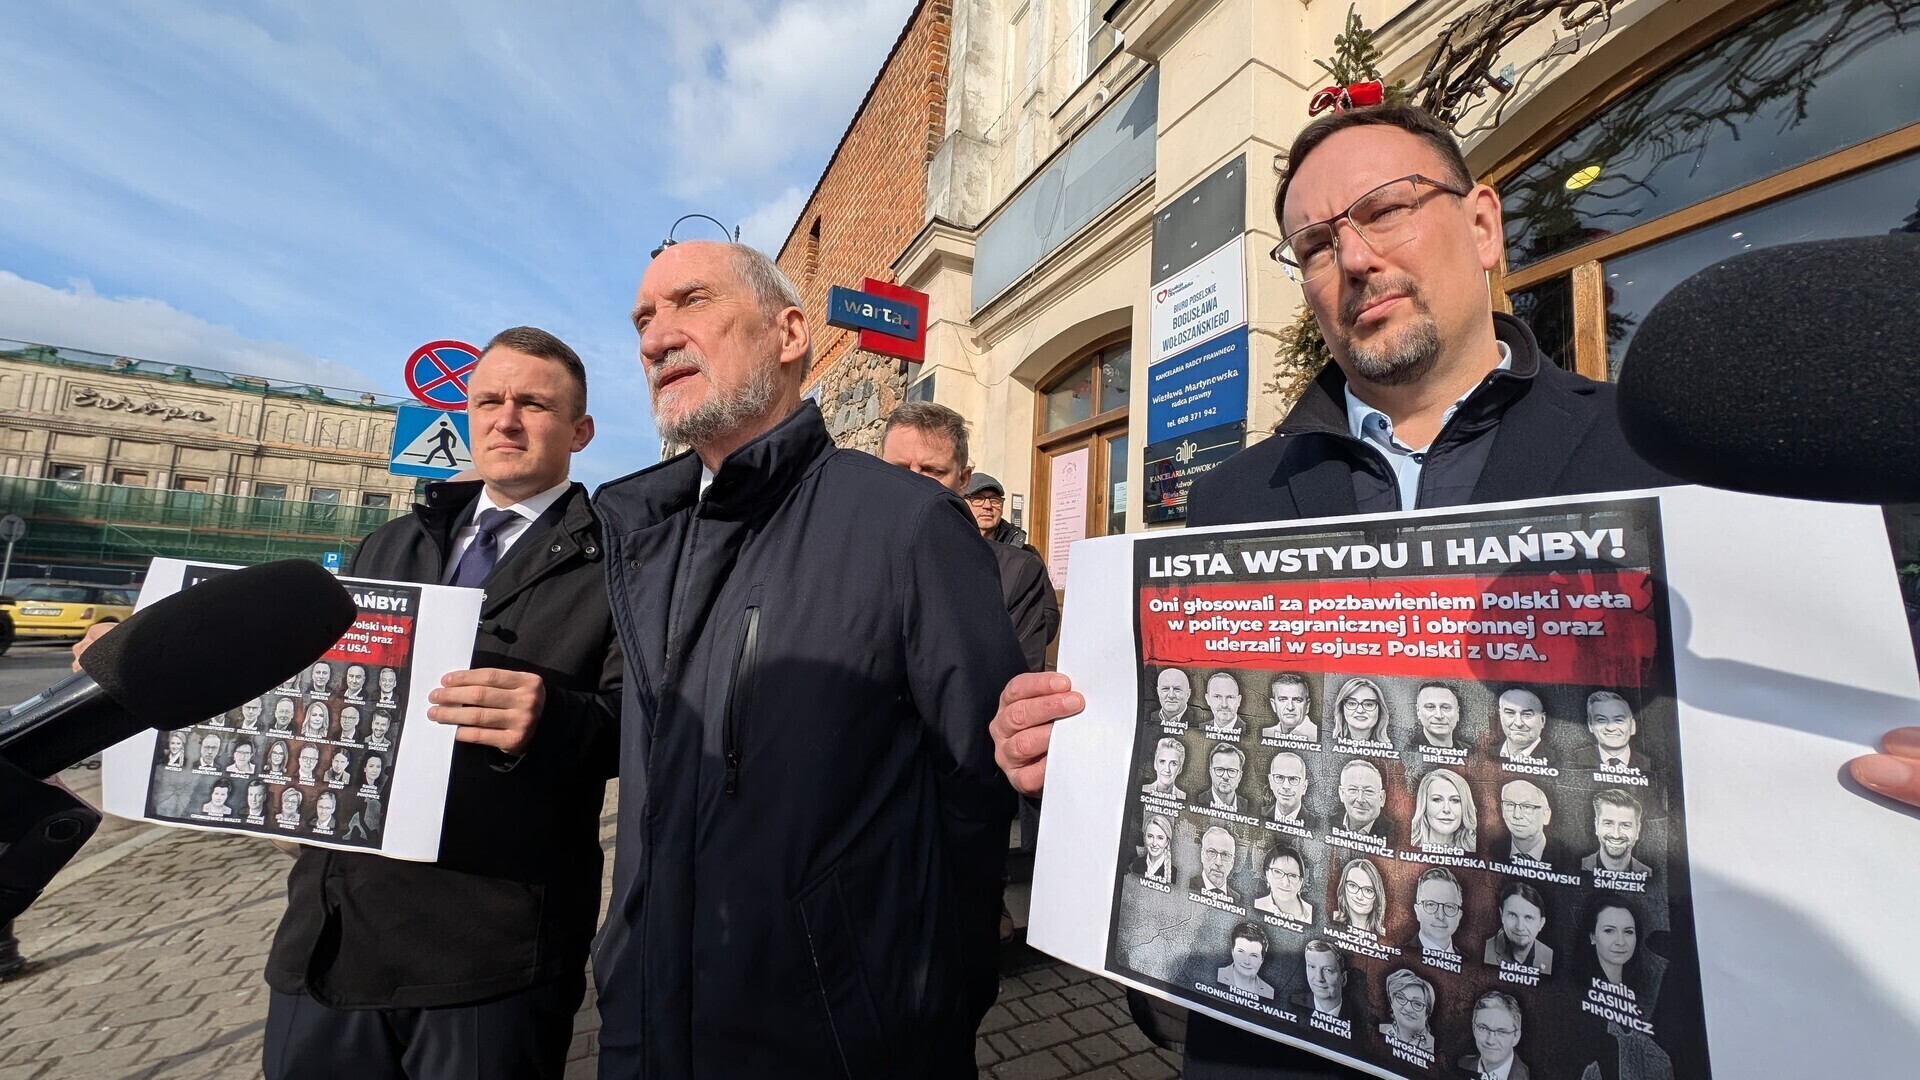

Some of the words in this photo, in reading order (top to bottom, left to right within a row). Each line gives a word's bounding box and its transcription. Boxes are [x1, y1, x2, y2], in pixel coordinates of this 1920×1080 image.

[1174, 299, 1188, 313] BIURO
[1190, 283, 1216, 305] POSELSKIE
[1172, 297, 1218, 330] BOGUSŁAWA
[1162, 310, 1230, 352] WOŁOSZAŃSKIEGO
[1156, 365, 1184, 382] KANCELARIA
[1185, 357, 1202, 369] RADCY
[1203, 344, 1236, 362] PRAWNEGO
[1152, 389, 1183, 404] Wiesława
[1184, 369, 1239, 392] Martynowska
[72, 387, 216, 421] Europa
[1172, 398, 1187, 408] radca
[1188, 390, 1212, 404] prawny
[1167, 420, 1176, 428] tel.
[1178, 415, 1188, 424] 608
[1190, 411, 1202, 421] 371
[1204, 407, 1217, 416] 942
[1150, 470, 1186, 483] KANCELARIA
[1187, 460, 1222, 476] ADWOKA
[1176, 479, 1194, 488] Adwok
[327, 554, 338, 563] P
[1150, 553, 1234, 578] LISTA
[1240, 542, 1408, 574] WSTYDU
[1422, 540, 1434, 567] I
[1446, 526, 1626, 566] HAŃBY!
[353, 591, 408, 612] AŃBY!
[1150, 597, 1178, 612] Oni
[1183, 595, 1275, 616] głosowali
[1279, 598, 1303, 611] za
[1308, 591, 1476, 614] pozbawieniem
[1481, 589, 1560, 610] Polski
[1566, 590, 1632, 610] veta
[381, 624, 404, 634] veta
[1168, 619, 1184, 632] w
[1188, 616, 1263, 634] polityce
[1268, 615, 1407, 636] zagranicznej
[1412, 615, 1420, 634] i
[1426, 615, 1536, 640] obronnej
[1542, 620, 1605, 637] oraz
[341, 632, 370, 643] onnej
[371, 636, 393, 645] oraz
[347, 644, 371, 654] USA.
[1205, 636, 1281, 654] uderzali
[1286, 641, 1306, 654] w
[1311, 638, 1382, 659] sojusz
[1387, 640, 1462, 660] Polski
[1468, 645, 1481, 659] z
[1486, 642, 1548, 662] USA.
[1160, 720, 1188, 730] Andrzej
[1164, 726, 1184, 736] BUŁA
[1205, 724, 1242, 736] Krzysztof
[1206, 732, 1240, 742] HETMAN
[1261, 738, 1322, 752] ARŁUKOWICZ
[1274, 732, 1308, 742] Bartosz
[1338, 736, 1393, 750] Magdalena
[1332, 745, 1400, 759] ADAMOWICZ
[1418, 744, 1468, 758] Krzysztof
[1422, 754, 1465, 766] BREJZA
[1510, 754, 1548, 766] Michał
[1502, 763, 1559, 776] KOBOSKO
[1600, 763, 1640, 776] Robert
[1594, 772, 1649, 786] BIEDROŃ
[1140, 795, 1186, 810] SCHEURING-
[1150, 789, 1176, 800] Joanna
[1144, 804, 1180, 818] WIELGUS
[1210, 801, 1238, 812] Michał
[1189, 804, 1260, 826] WAWRYKIEWICZ
[1274, 814, 1304, 828] Michał
[1265, 822, 1313, 839] SZCZERBA
[1332, 827, 1387, 847] Bartłomiej
[1324, 836, 1394, 858] SIENKIEWICZ
[1422, 843, 1464, 856] Elżbieta
[1400, 852, 1486, 869] ŁUKACIJEWSKA
[1511, 855, 1552, 870] Janusz
[1144, 872, 1167, 884] Marta
[1489, 861, 1580, 886] LEWANDOWSKI
[1594, 868, 1648, 882] Krzysztof
[1140, 878, 1171, 894] WCISŁO
[1594, 877, 1645, 892] ŚMISZEK
[1201, 888, 1234, 904] Bogdan
[1188, 893, 1246, 916] ZDROJEWSKI
[1264, 914, 1304, 933] KOPACZ
[1274, 910, 1294, 921] Ewa
[1324, 927, 1401, 956] MARCZUŁAJTIS
[1347, 925, 1378, 942] Jagna
[1334, 940, 1390, 961] -WALCZAK
[1422, 948, 1462, 963] Dariusz
[1422, 956, 1461, 974] JOŃSKI
[1500, 960, 1540, 976] Łukasz
[1499, 971, 1540, 986] KOHUT
[1230, 985, 1259, 1001] Hanna
[1592, 976, 1636, 1000] Kamila
[1195, 982, 1297, 1023] GRONKIEWICZ-WALTZ
[1588, 990, 1642, 1015] GASIUK-
[1312, 1010, 1351, 1030] Andrzej
[1582, 1000, 1655, 1035] PIHOWICZ
[1310, 1019, 1351, 1040] HALICKI
[1386, 1035, 1434, 1062] Mirosława
[1392, 1047, 1428, 1069] NYKIEL
